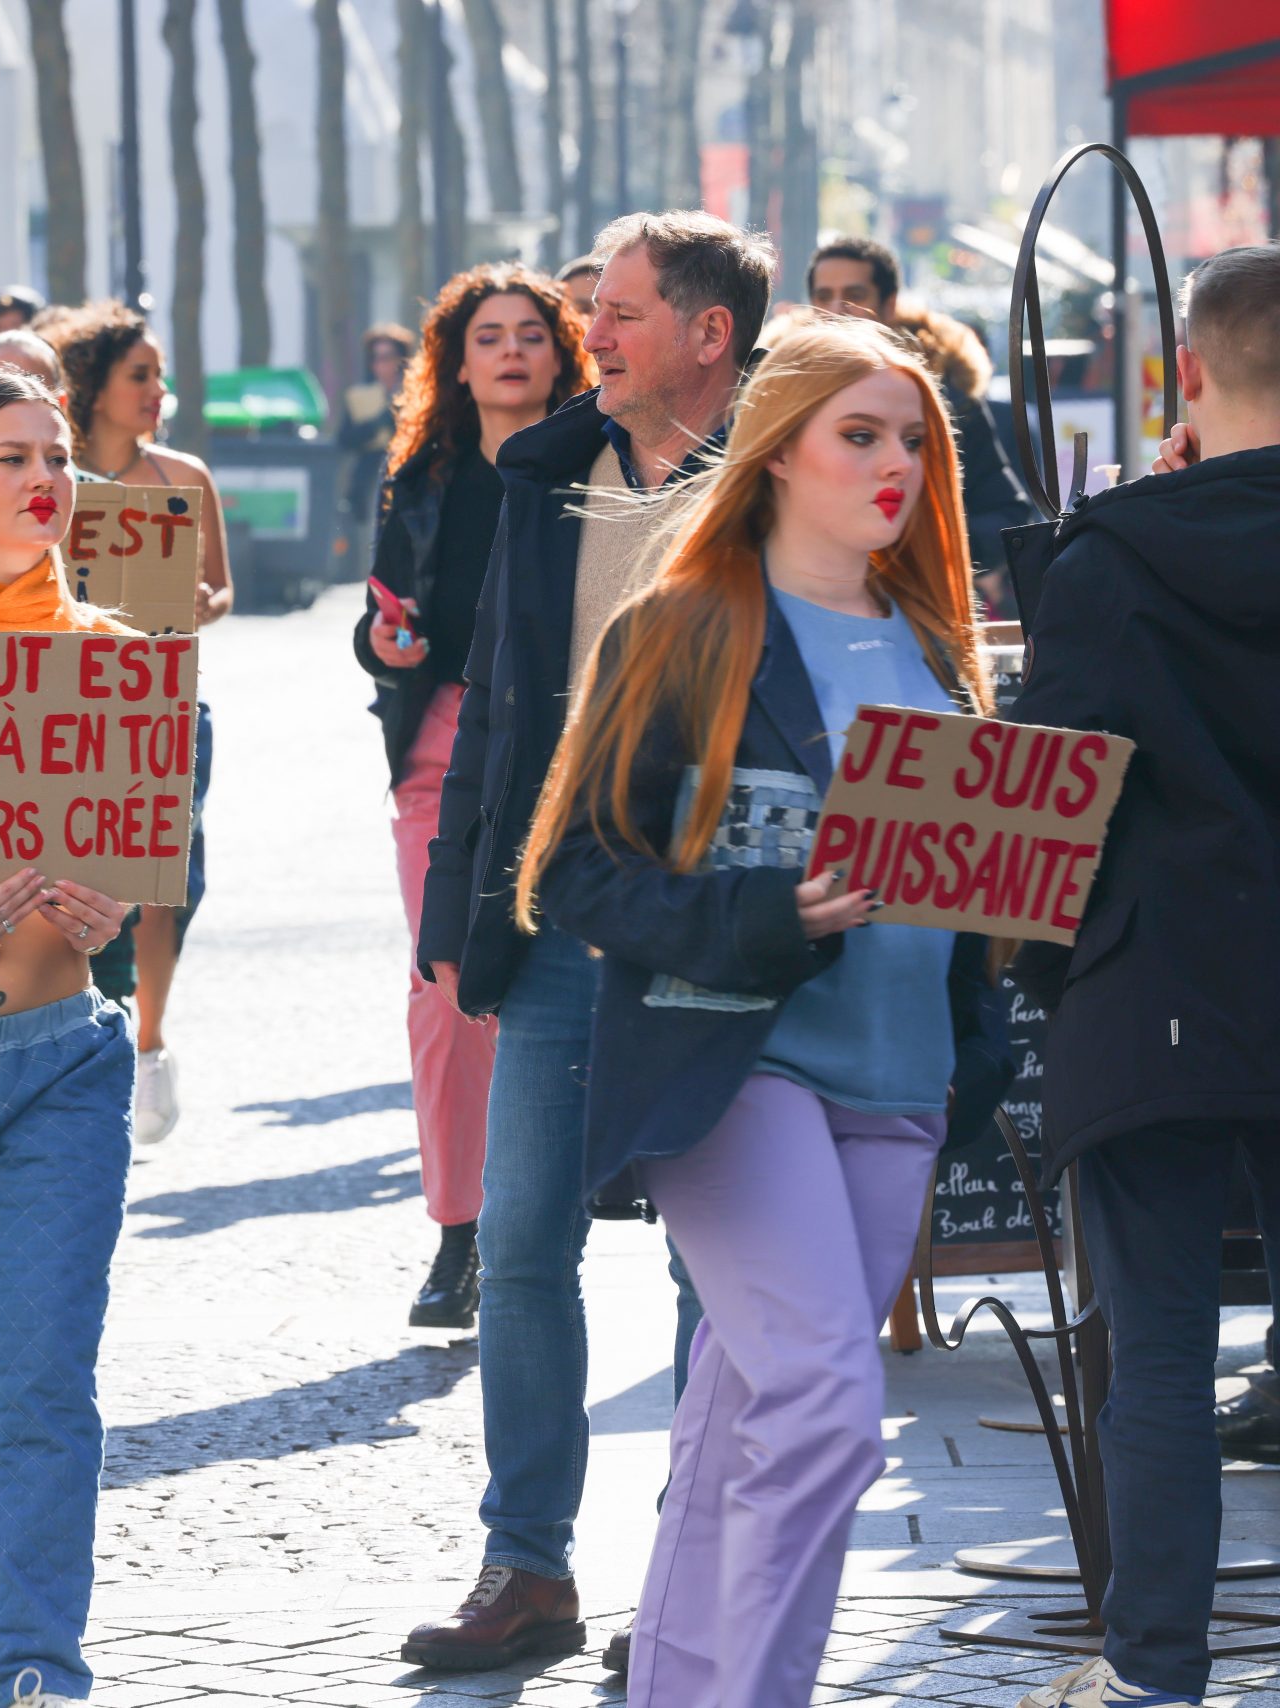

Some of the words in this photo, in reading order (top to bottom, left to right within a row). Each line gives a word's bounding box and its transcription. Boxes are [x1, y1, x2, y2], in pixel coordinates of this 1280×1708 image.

[68, 507, 194, 561] EST
[79, 637, 192, 701] EST
[40, 712, 106, 774] EN
[842, 709, 941, 790] JE
[953, 721, 1108, 819] SUIS
[64, 781, 180, 858] CRÉE
[809, 813, 1098, 930] PUISSANTE
